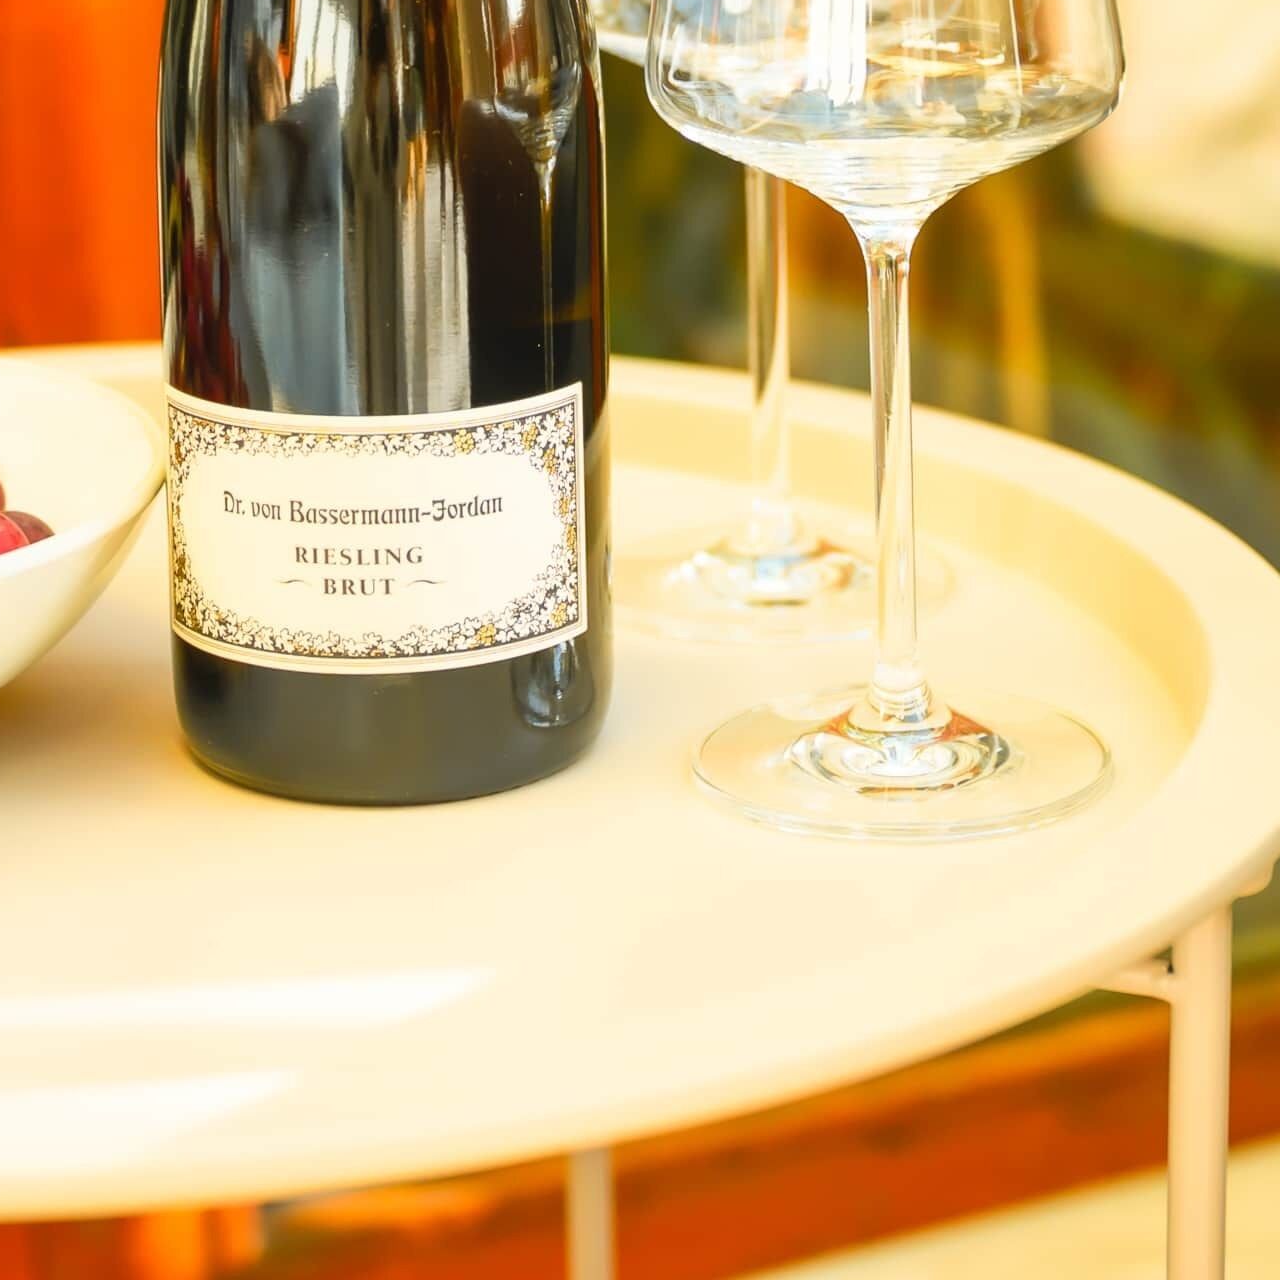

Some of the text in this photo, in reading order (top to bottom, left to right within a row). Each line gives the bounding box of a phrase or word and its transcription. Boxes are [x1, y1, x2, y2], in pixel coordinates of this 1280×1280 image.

[223, 490, 503, 525] Dr. von Bassermann-Jordan
[295, 546, 424, 566] RIESLING
[323, 578, 396, 596] BRUT
